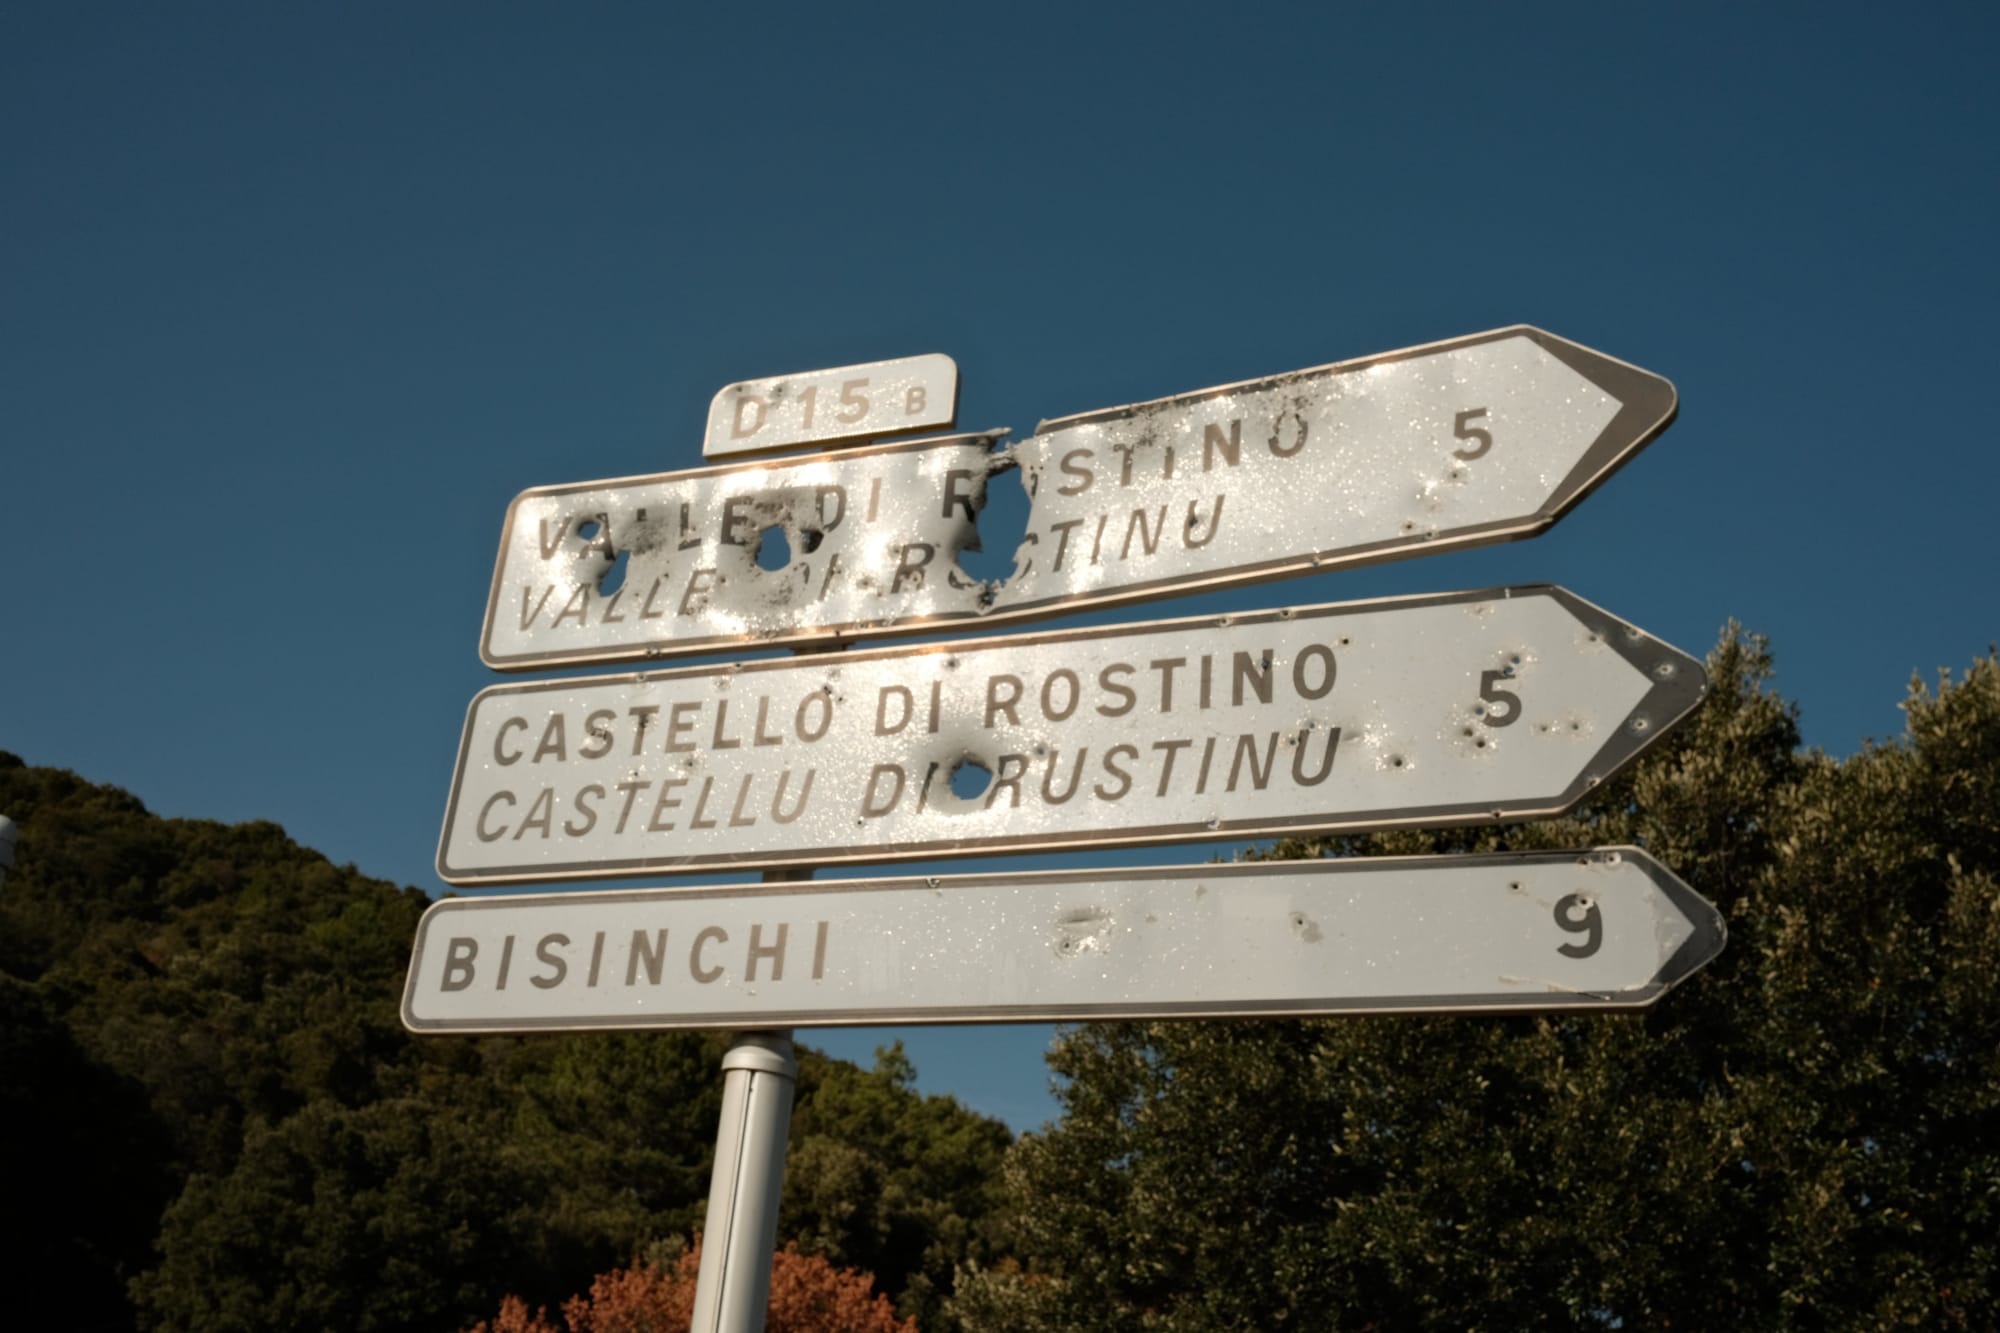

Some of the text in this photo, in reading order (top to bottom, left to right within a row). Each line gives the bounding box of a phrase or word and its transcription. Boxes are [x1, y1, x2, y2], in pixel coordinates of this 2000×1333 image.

[731, 378, 926, 440] D 15 B
[1452, 407, 1494, 462] 5
[539, 495, 757, 561] VALE
[941, 408, 1309, 521] RSTINO
[492, 643, 1338, 767] CASTELLO DI ROSTINO
[1479, 670, 1523, 728] 5
[475, 726, 1342, 843] CASTELLU DI RUSTINU
[439, 893, 1603, 992] BISINCHI 9
